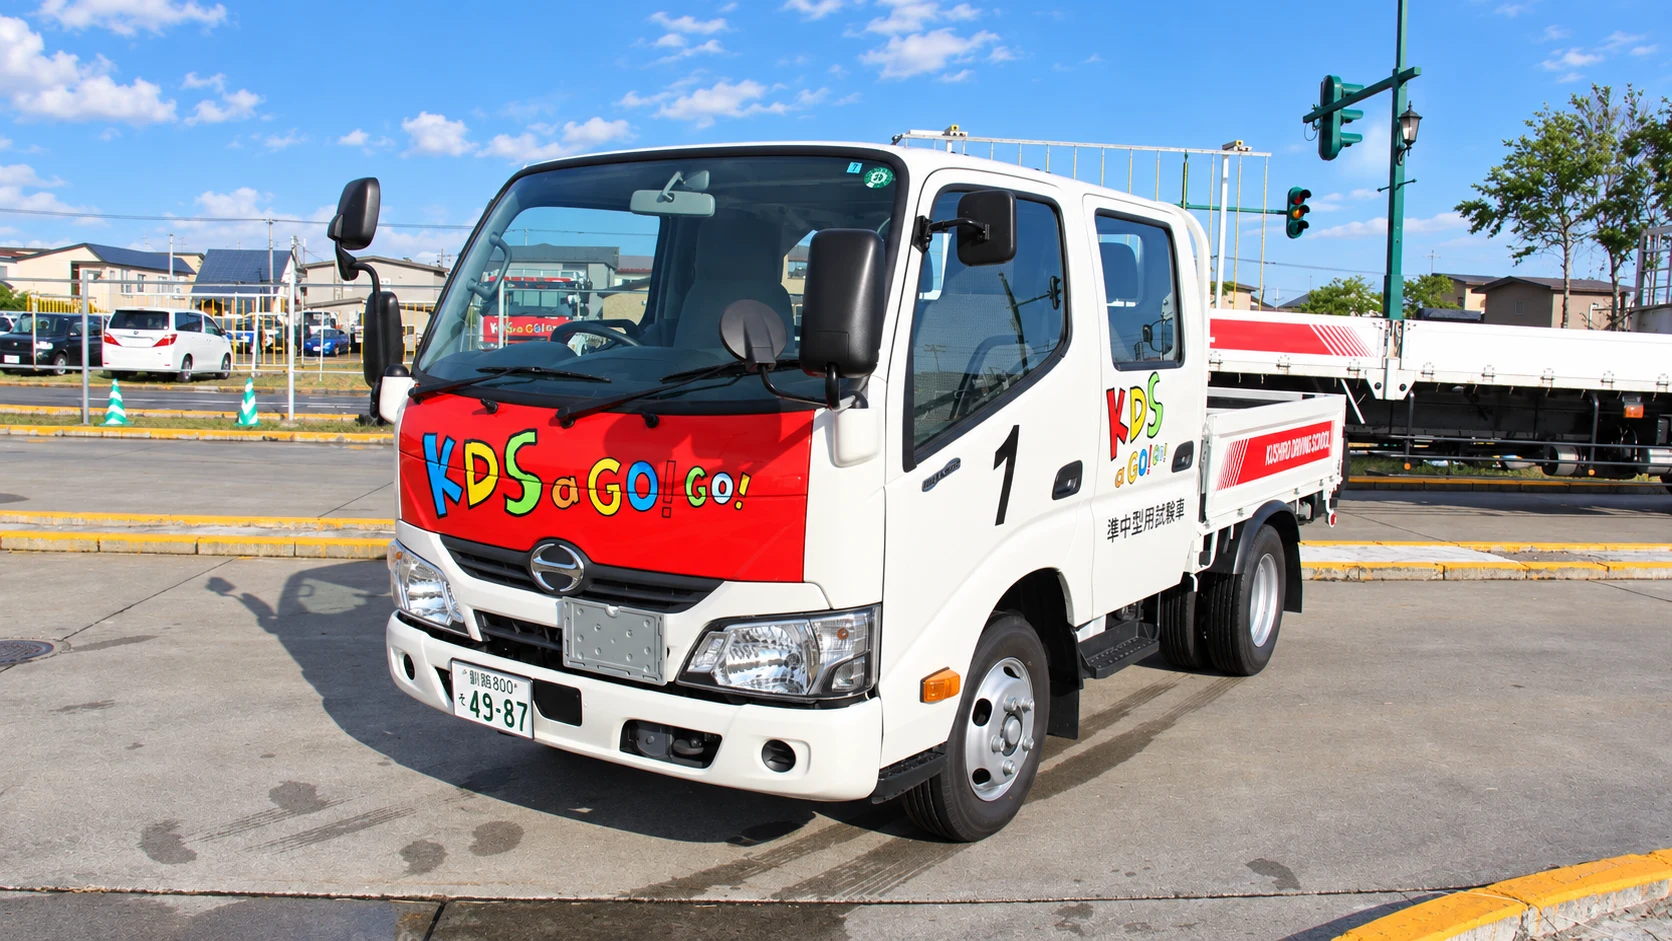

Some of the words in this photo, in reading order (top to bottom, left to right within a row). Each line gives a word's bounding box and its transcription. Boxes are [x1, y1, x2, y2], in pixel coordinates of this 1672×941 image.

[1106, 372, 1164, 461] KDS
[1115, 467, 1125, 488] a
[1127, 444, 1153, 485] GO!
[1265, 441, 1291, 465] KUSHIRO
[1291, 436, 1311, 458] DRIVING
[1312, 431, 1330, 452] SCHOOL
[422, 428, 543, 518] KDS
[551, 475, 581, 510] a
[587, 457, 677, 519] GO!
[993, 424, 1020, 526] 1
[1107, 497, 1185, 543] 準中型用試験車
[469, 690, 528, 732] 49-87
